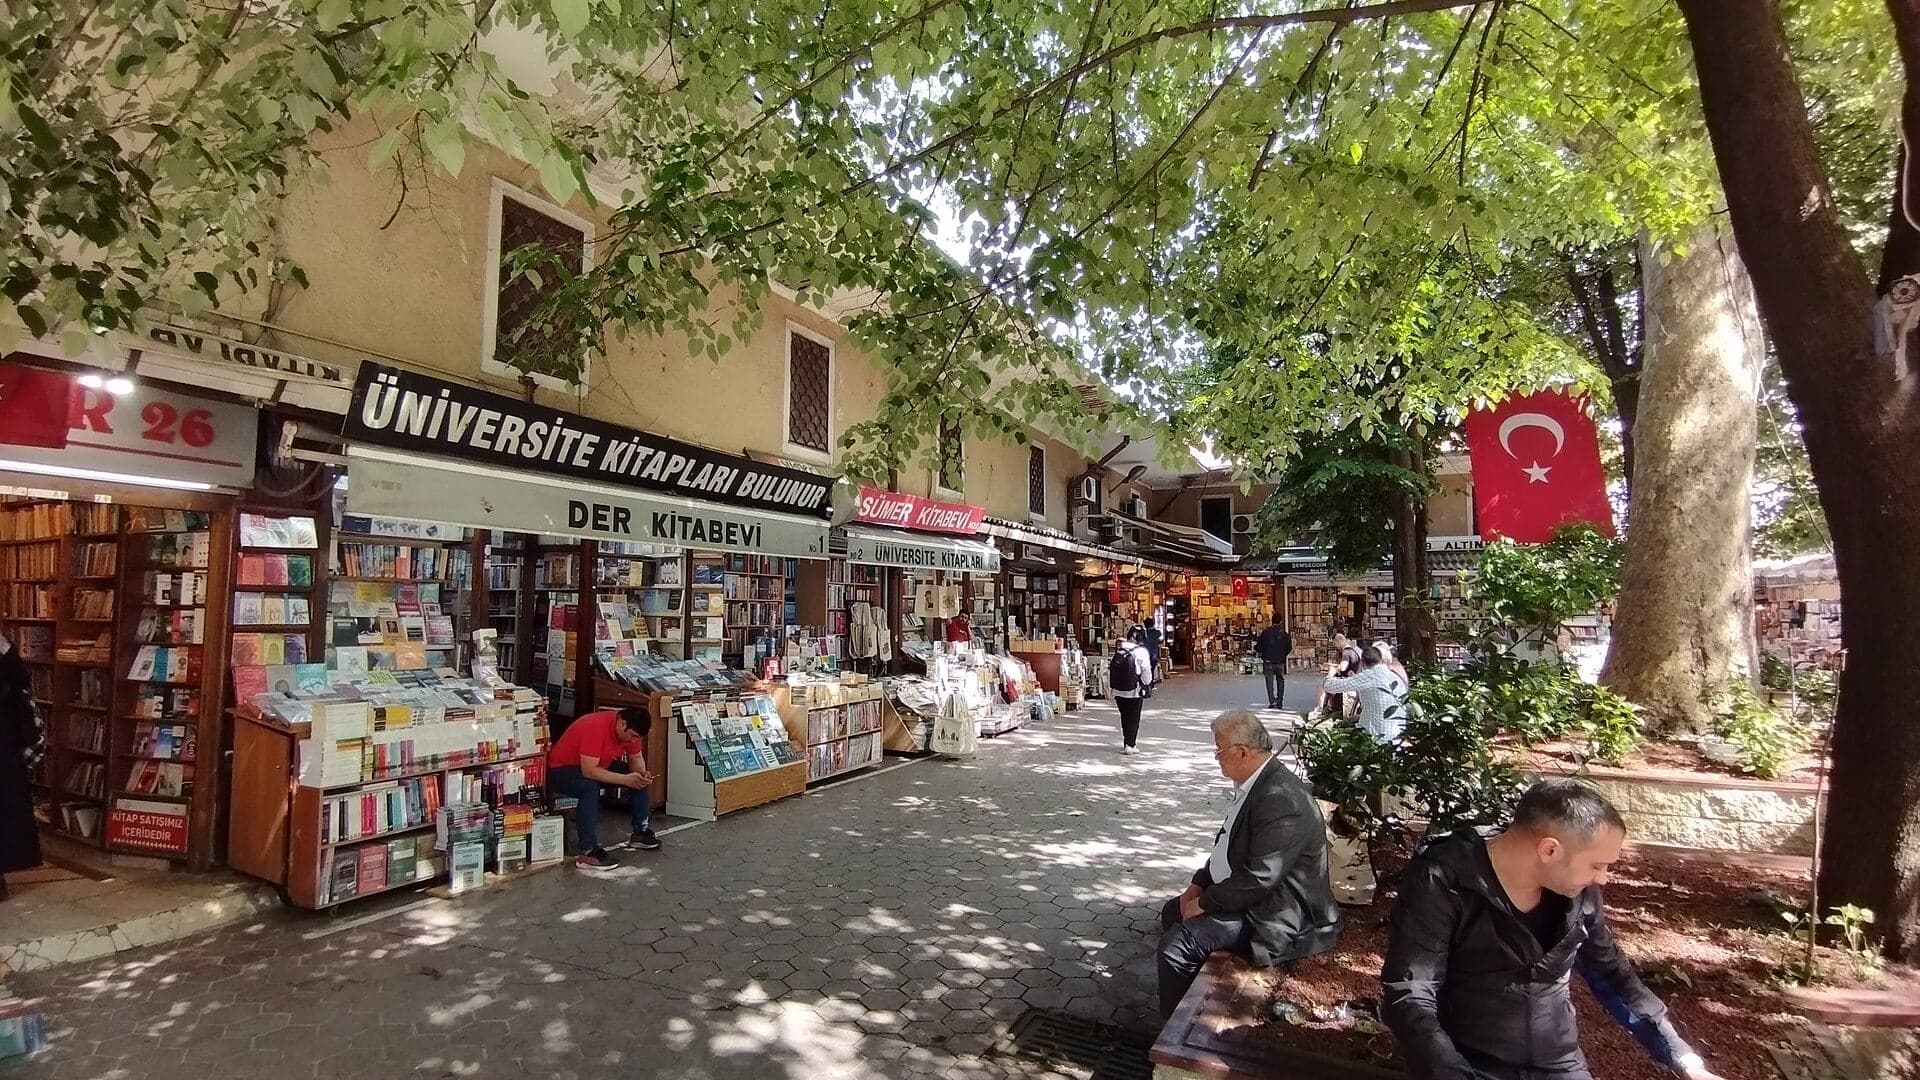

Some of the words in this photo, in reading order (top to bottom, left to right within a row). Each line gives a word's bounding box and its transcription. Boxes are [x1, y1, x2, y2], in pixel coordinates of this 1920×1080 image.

[141, 402, 215, 447] 26
[362, 372, 601, 468] ÜNİVERSİTE
[599, 436, 739, 494] KİTAPLARI
[736, 472, 826, 509] BULUNUR
[568, 499, 632, 534] DER
[651, 510, 762, 548] KİTABEVİ
[859, 494, 913, 526] SÜMER
[916, 504, 971, 530] KİTABEVİ
[875, 542, 936, 566] ÜNİVERSİTE
[941, 549, 983, 569] KİTAPLARI
[112, 811, 138, 822] KİTAP
[139, 815, 183, 828] SATIŞIMIZ
[121, 825, 171, 840] İÇERİDEDİR
